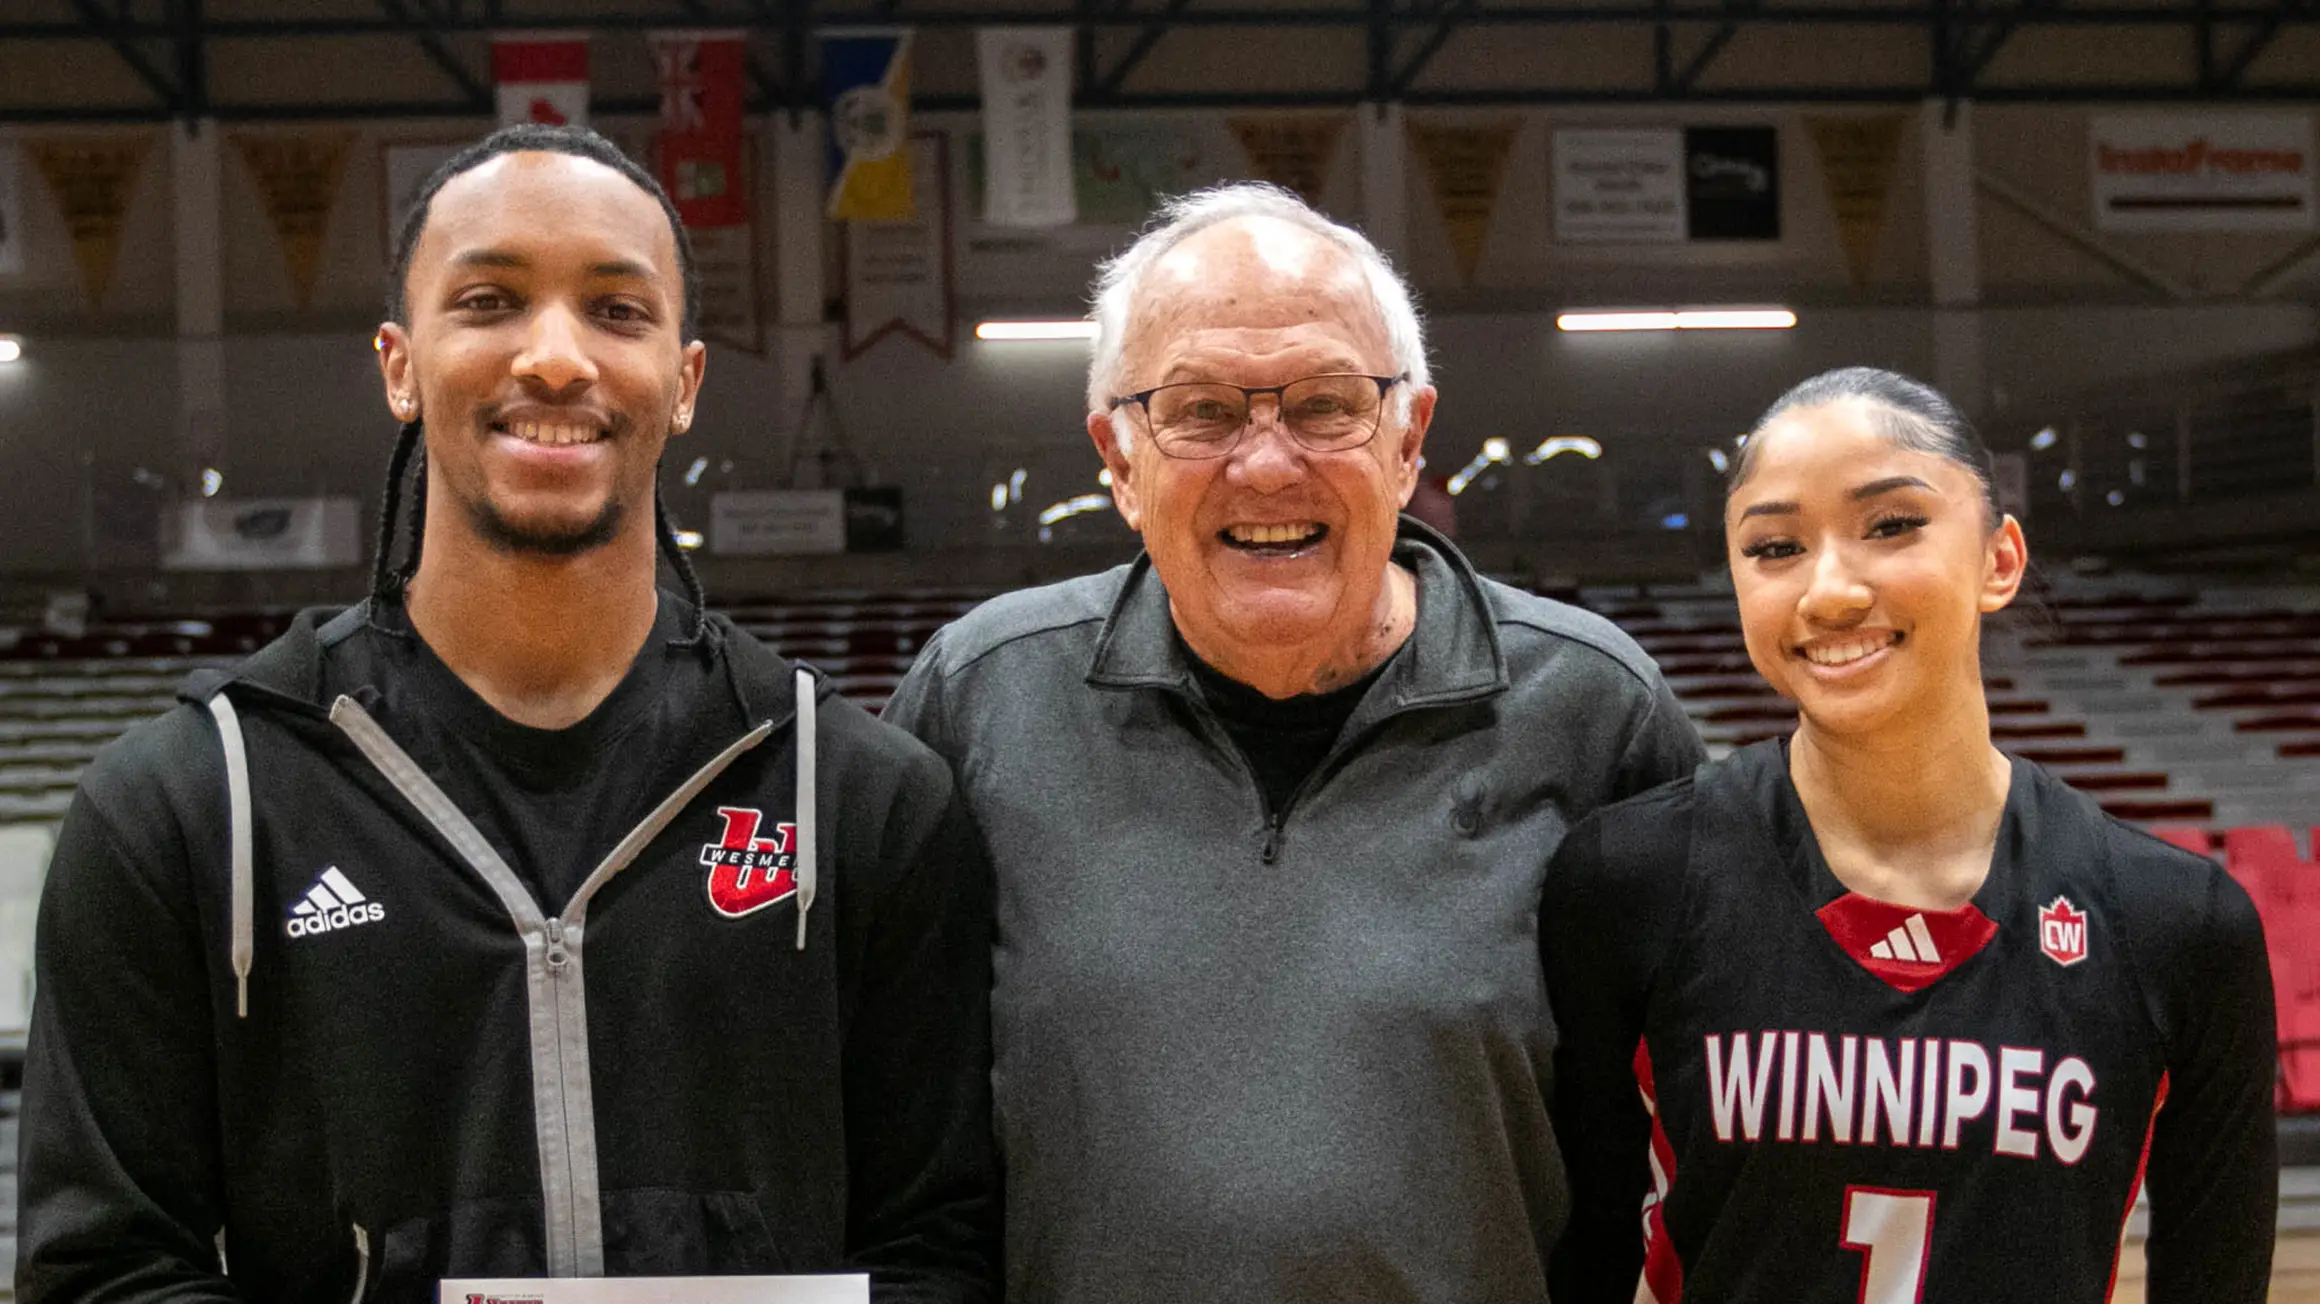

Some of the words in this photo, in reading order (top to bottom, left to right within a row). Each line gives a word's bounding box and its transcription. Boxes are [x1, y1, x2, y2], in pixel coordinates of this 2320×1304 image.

[287, 903, 385, 938] adidas
[2045, 920, 2081, 953] CW
[1705, 1031, 2097, 1164] WINNIPEG
[1839, 1183, 1937, 1304] 1
